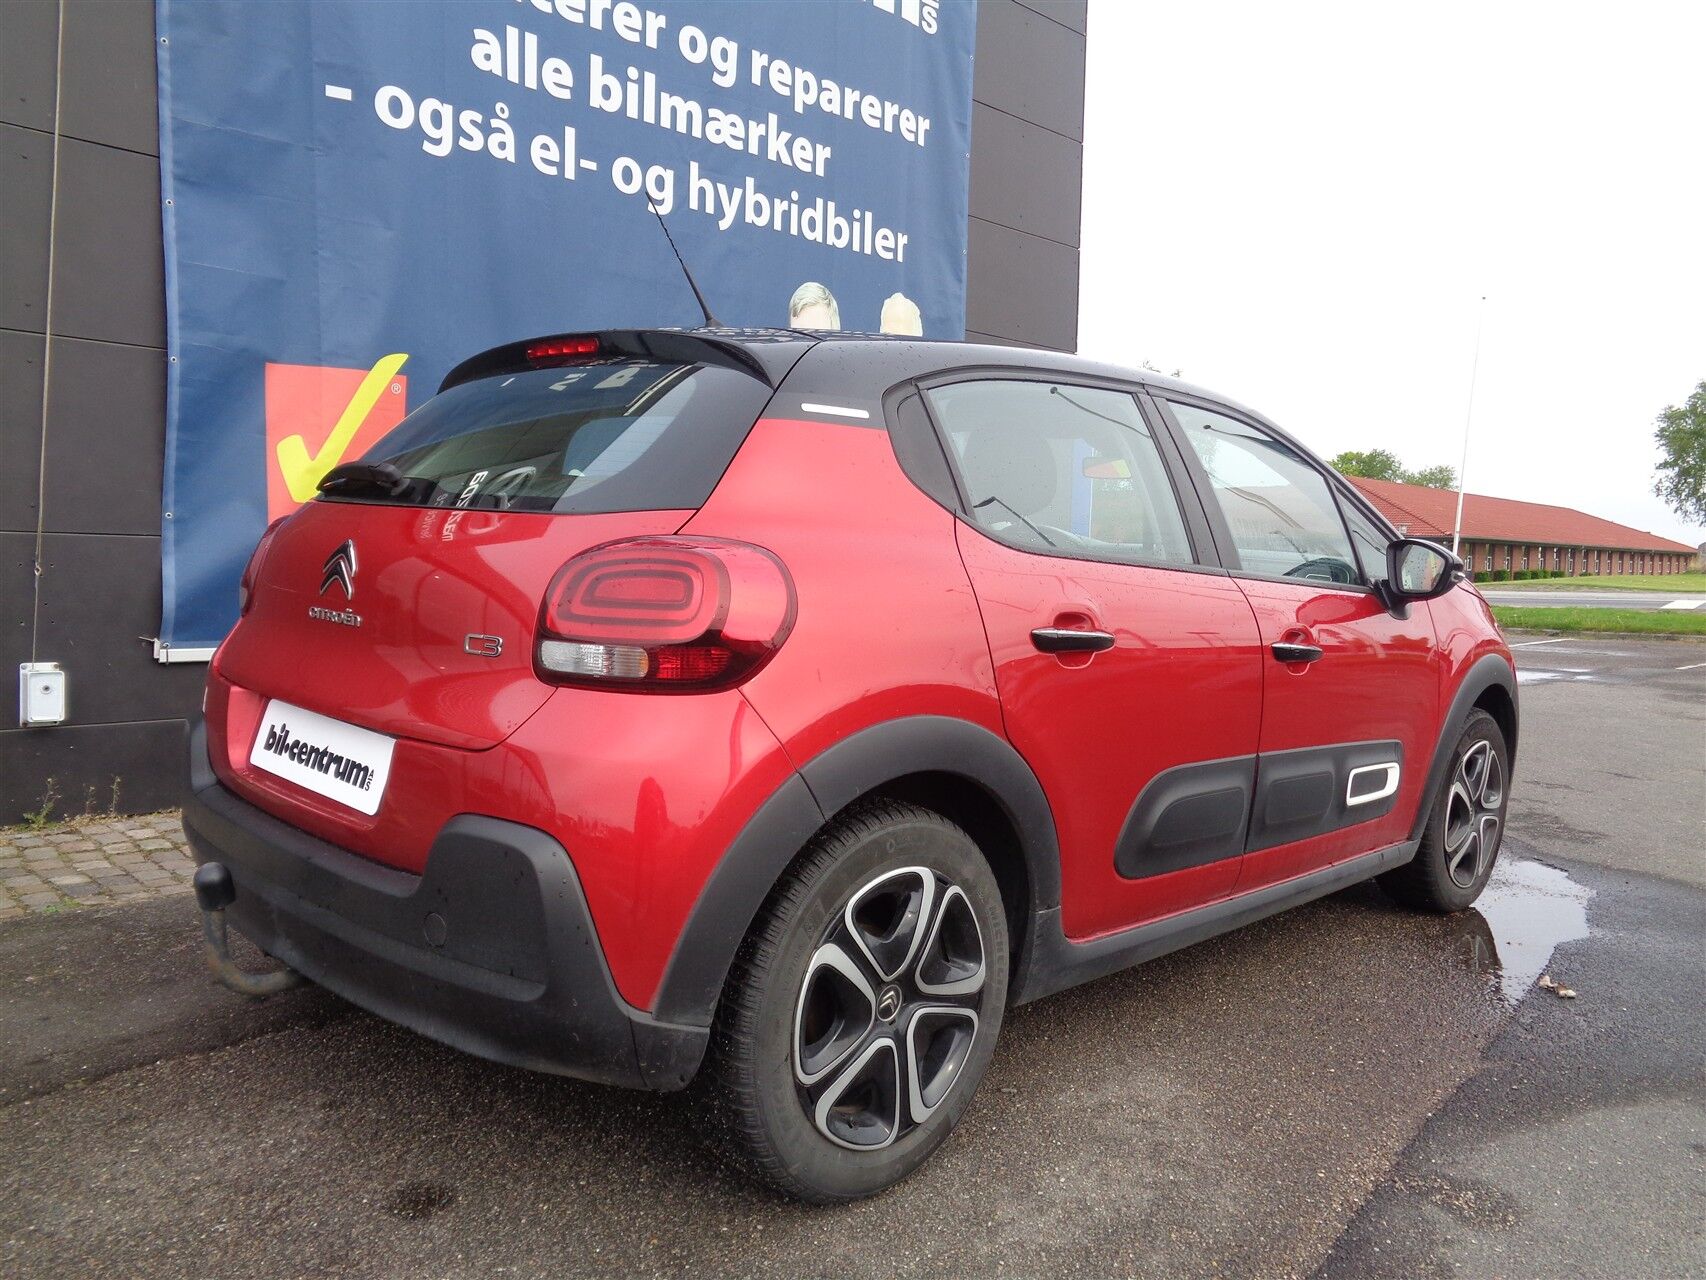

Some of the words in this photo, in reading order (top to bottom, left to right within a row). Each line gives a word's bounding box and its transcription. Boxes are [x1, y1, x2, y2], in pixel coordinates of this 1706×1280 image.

[470, 24, 574, 100] alle
[589, 53, 832, 178] bilmærker
[678, 24, 739, 88] og
[751, 49, 931, 147] reparerer
[374, 85, 516, 164] også
[530, 125, 598, 181] el-
[611, 156, 675, 216] og
[689, 160, 908, 263] hybridbiler
[464, 633, 503, 657] C3
